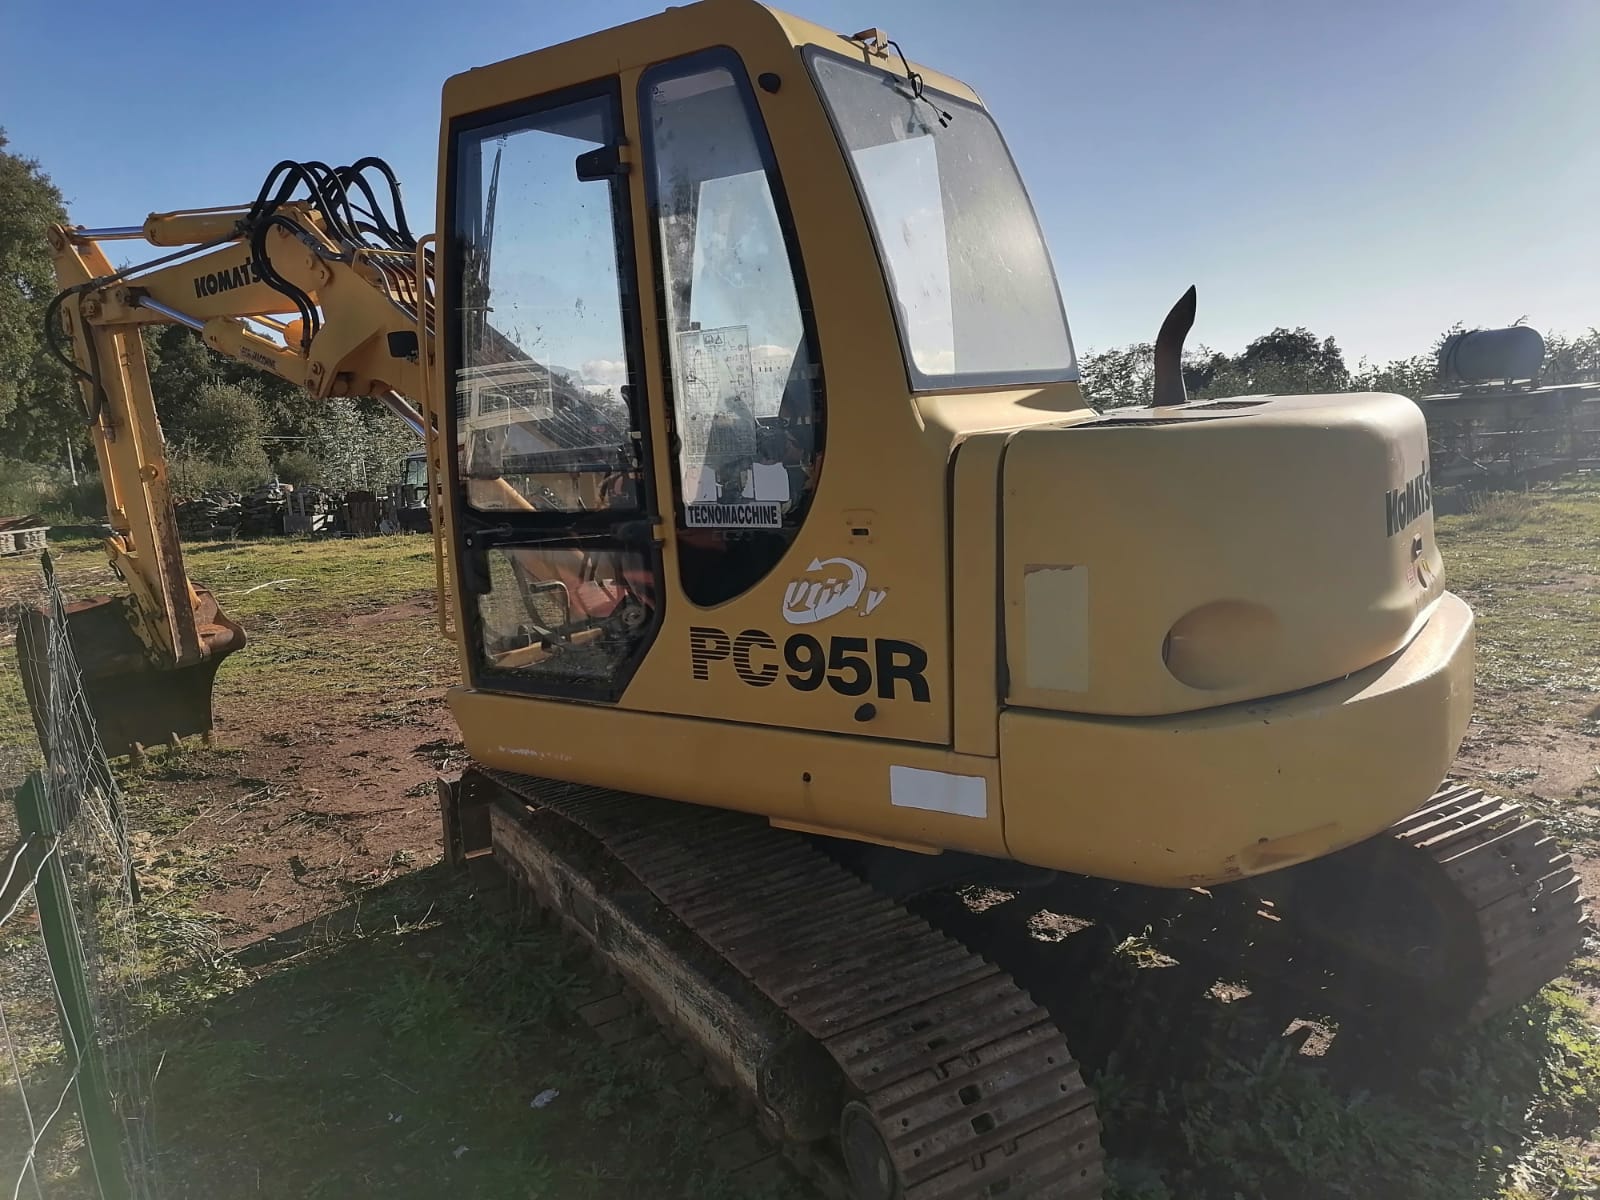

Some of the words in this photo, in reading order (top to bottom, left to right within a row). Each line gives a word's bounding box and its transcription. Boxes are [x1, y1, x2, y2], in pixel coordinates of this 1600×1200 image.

[194, 257, 263, 298] KOMATS
[687, 505, 778, 525] TECNOMACCHINE
[1385, 460, 1431, 537] KOMATS
[690, 626, 931, 703] PC95R
